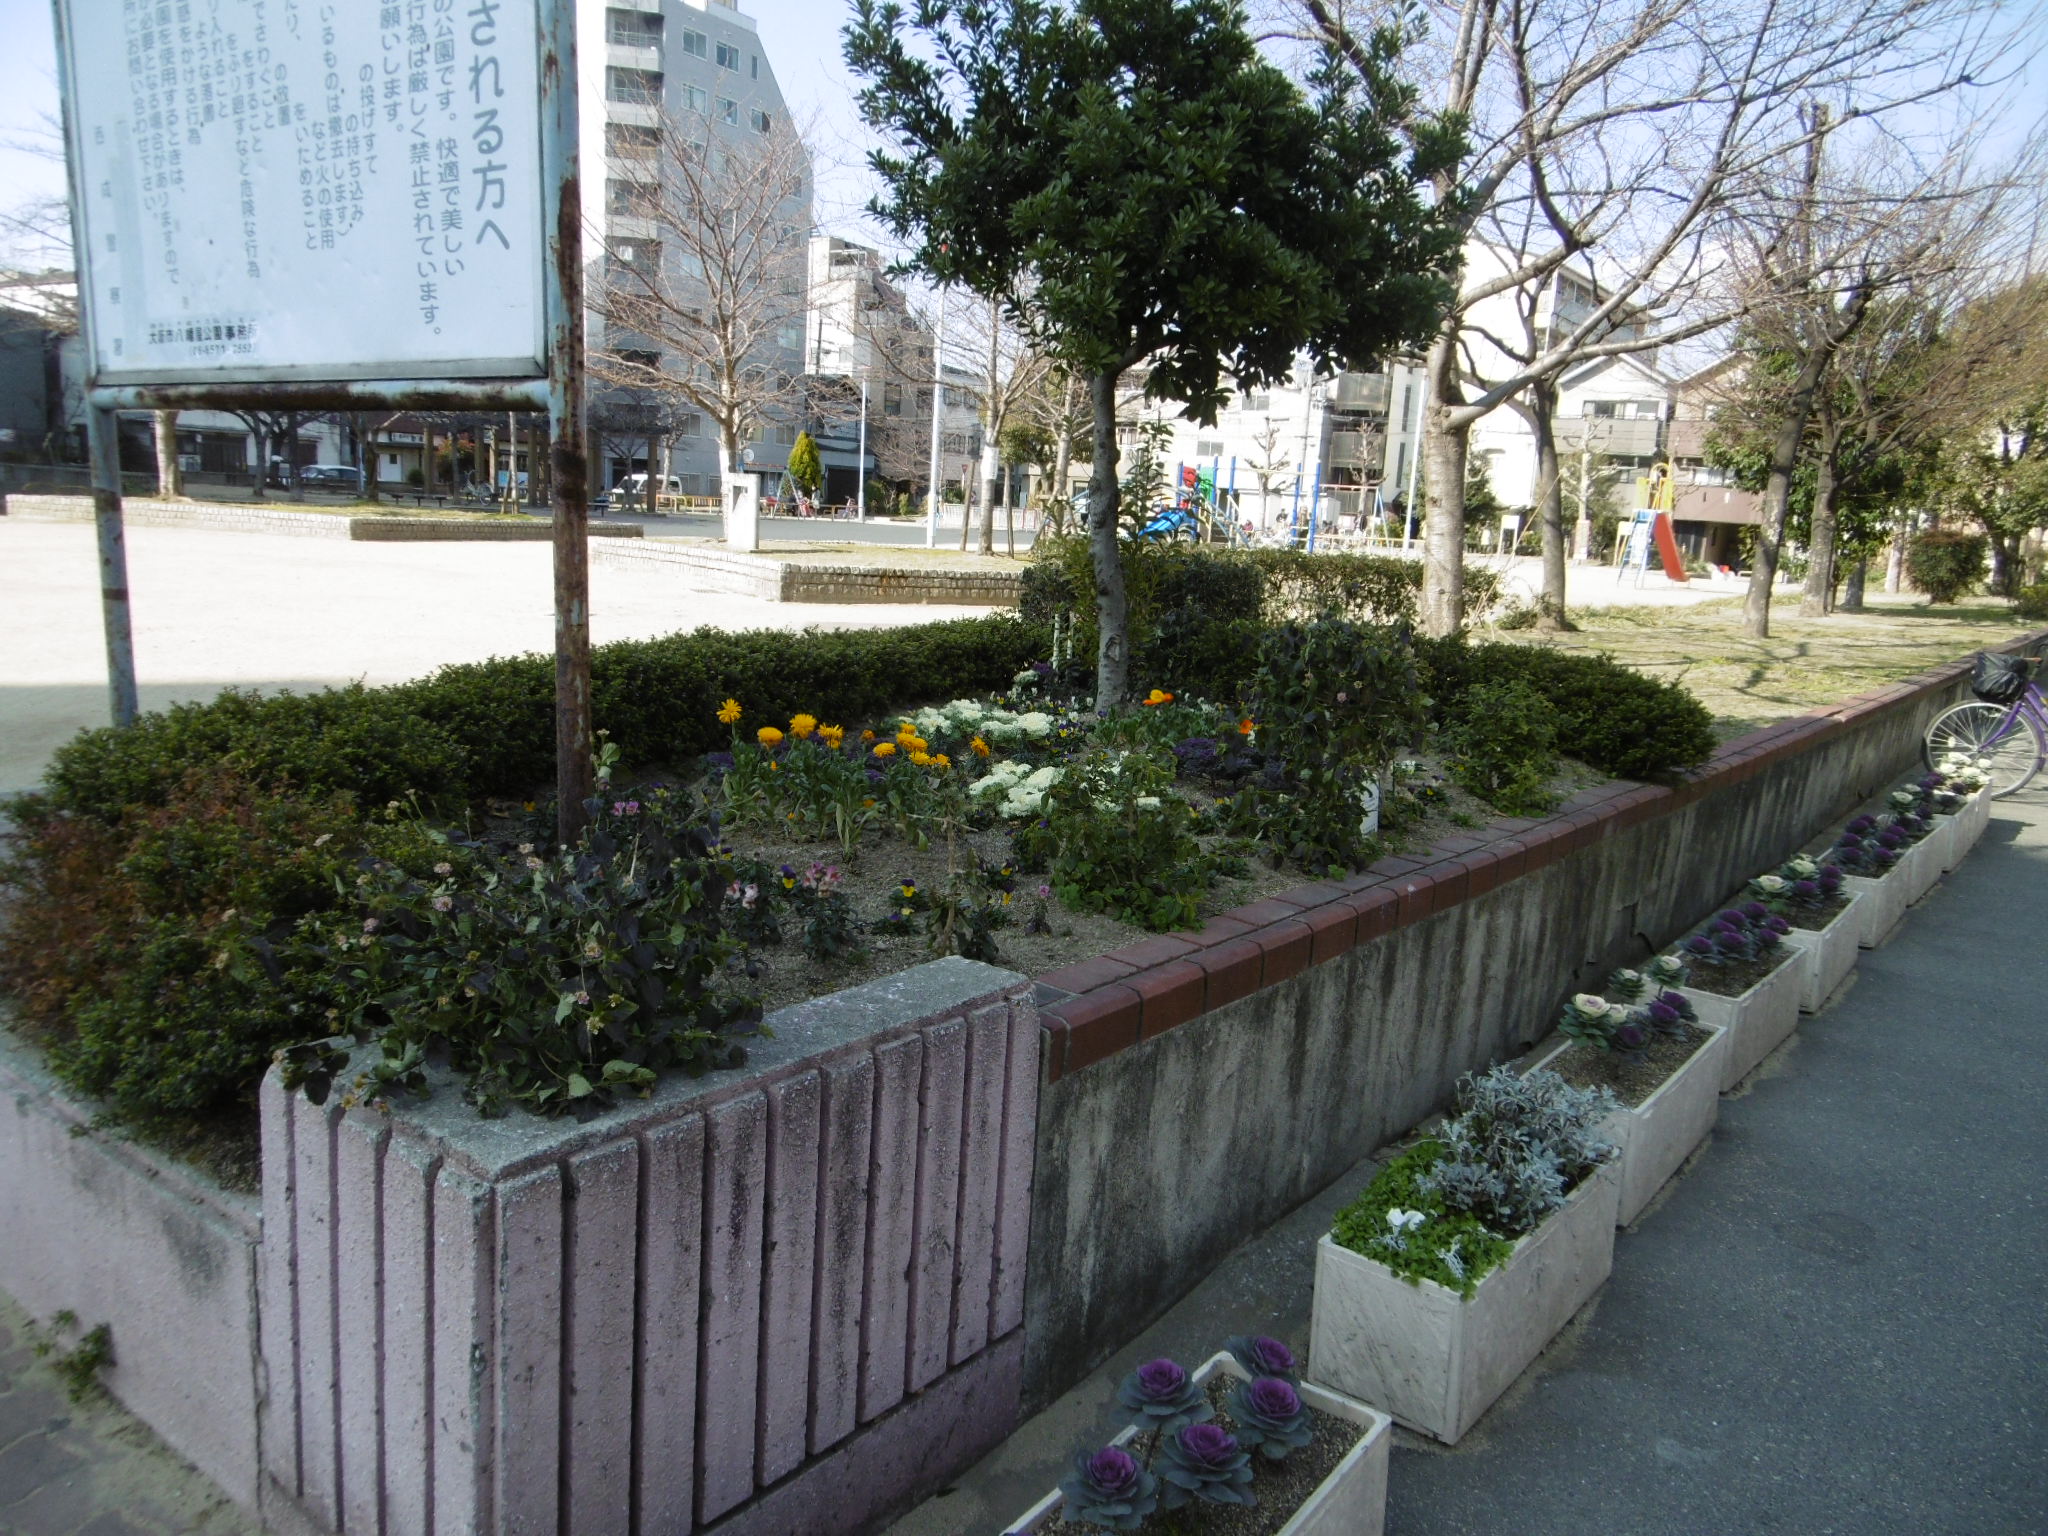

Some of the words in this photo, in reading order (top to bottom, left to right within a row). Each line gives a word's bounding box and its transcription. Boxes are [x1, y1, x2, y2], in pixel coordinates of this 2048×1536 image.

[154, 0, 185, 193] 園を使用するときは、
[380, 0, 404, 133] 願いします。
